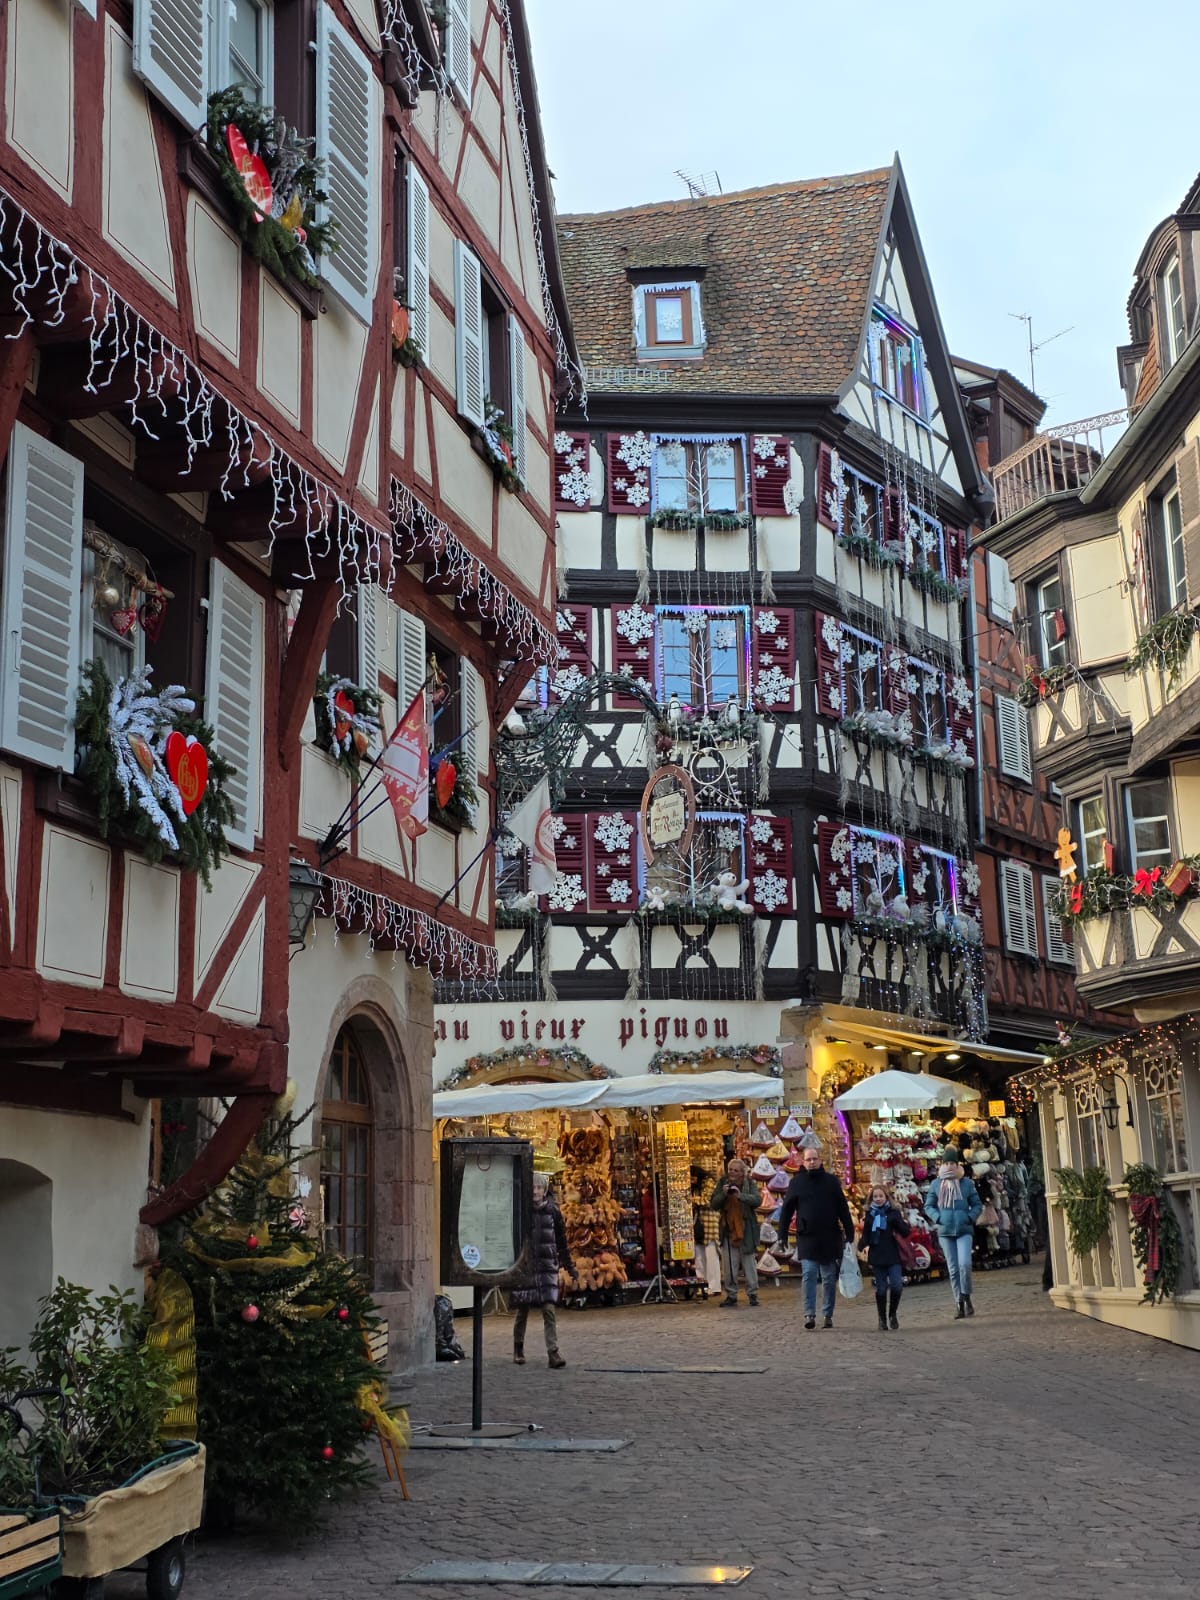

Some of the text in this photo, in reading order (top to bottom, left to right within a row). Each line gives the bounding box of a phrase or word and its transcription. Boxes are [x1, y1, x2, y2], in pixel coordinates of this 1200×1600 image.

[434, 1007, 729, 1050] au vieux pignon
